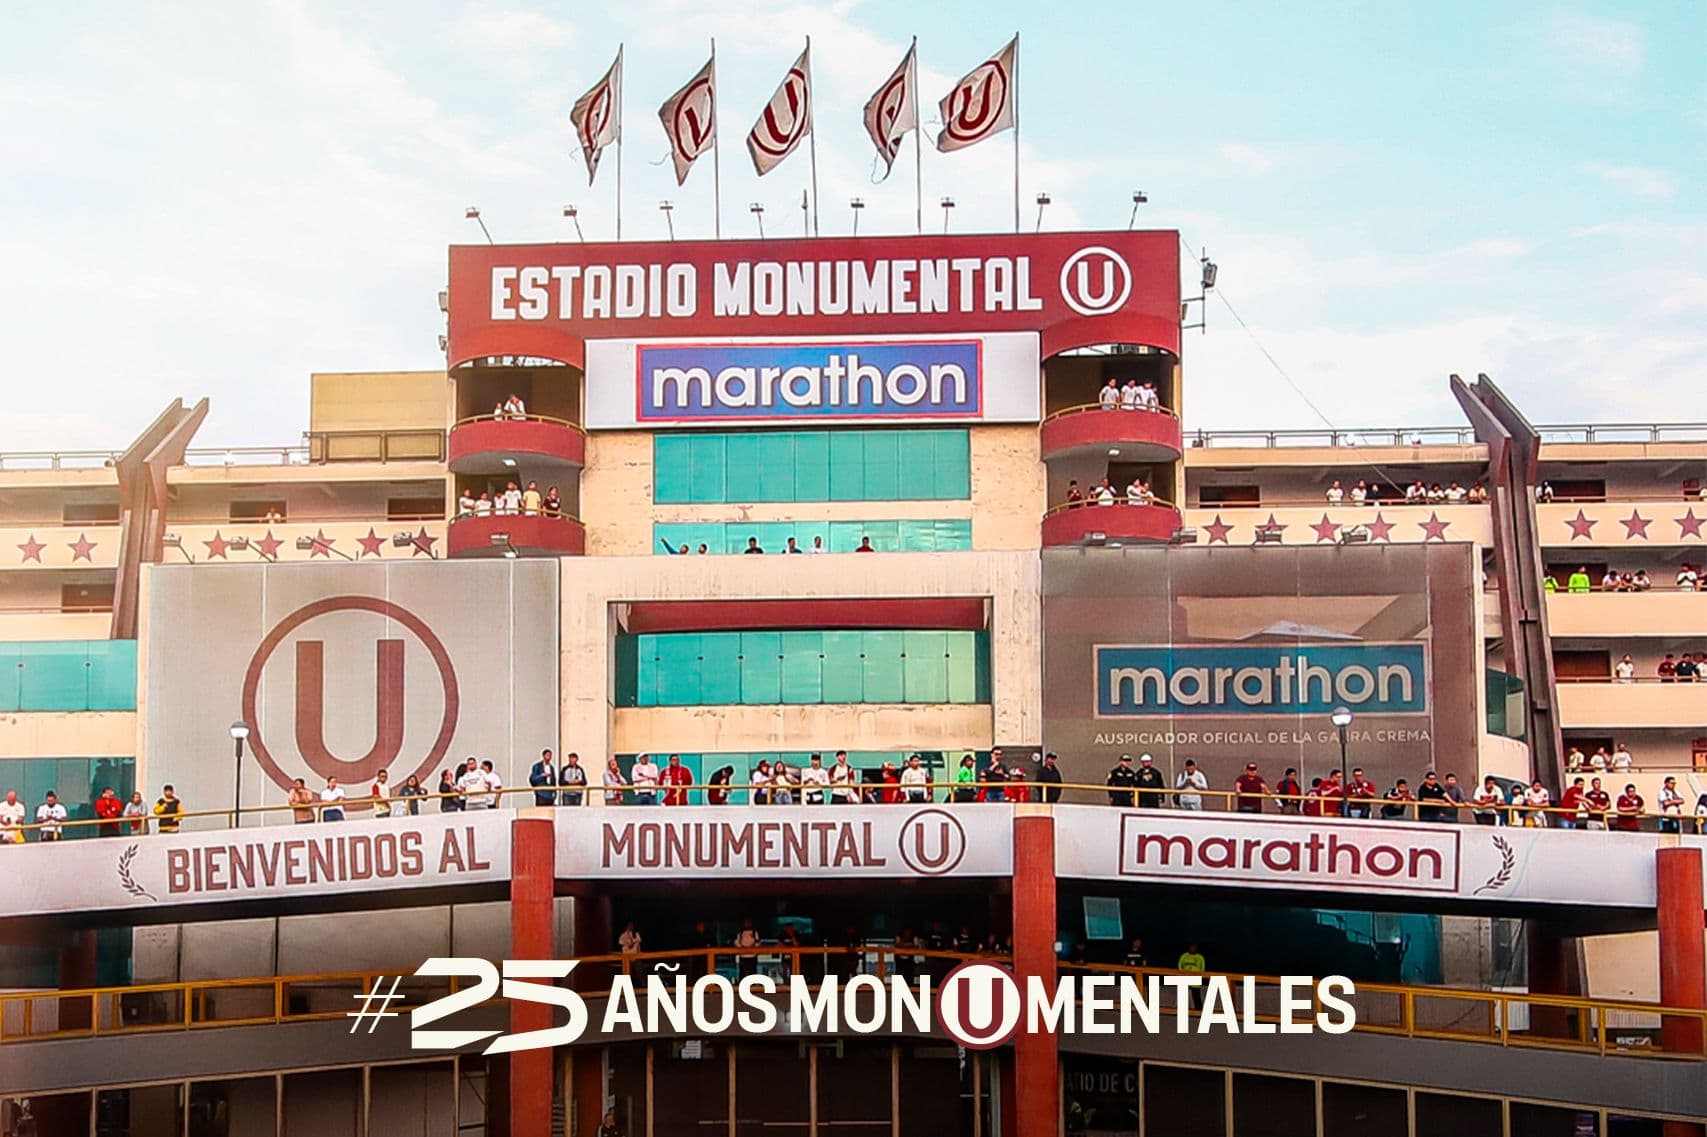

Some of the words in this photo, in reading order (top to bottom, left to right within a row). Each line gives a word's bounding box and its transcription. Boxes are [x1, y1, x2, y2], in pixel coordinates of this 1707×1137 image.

[491, 263, 697, 320] ESTADIO
[714, 256, 1042, 317] MONUMENTAL
[652, 354, 967, 409] marathon
[1110, 656, 1413, 706] marathon
[1094, 732, 1198, 745] AUSPICIADOR
[1203, 731, 1263, 744] OFICIAL
[1268, 731, 1288, 744] DE
[1292, 731, 1313, 744] LA
[1376, 729, 1432, 743] CREMA
[167, 830, 424, 894] BIENVENIDOS
[437, 826, 491, 873] AL
[602, 822, 886, 868] MONUMENTAL
[1136, 833, 1443, 880] marathon
[1099, 1072, 1120, 1093] DE
